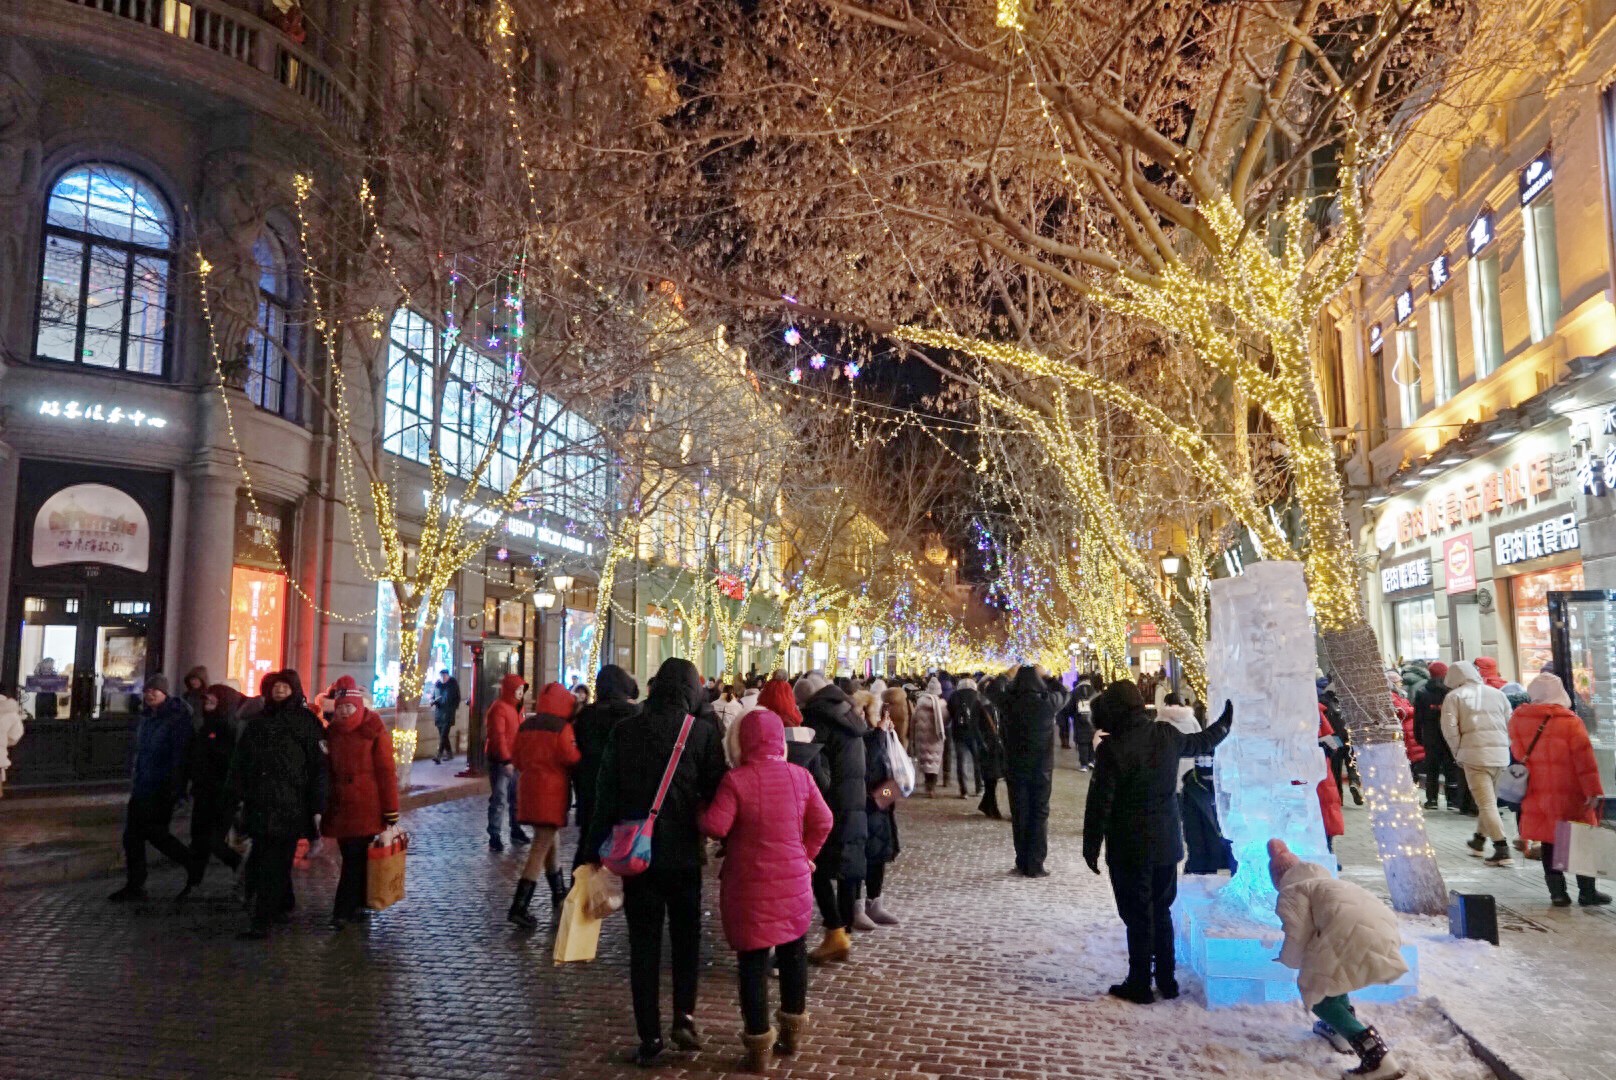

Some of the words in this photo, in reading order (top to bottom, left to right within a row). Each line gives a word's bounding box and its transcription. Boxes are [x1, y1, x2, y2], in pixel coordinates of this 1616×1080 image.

[1396, 455, 1553, 545] 哈肉联食品旗舰店
[1494, 512, 1580, 566] 哈肉联食品
